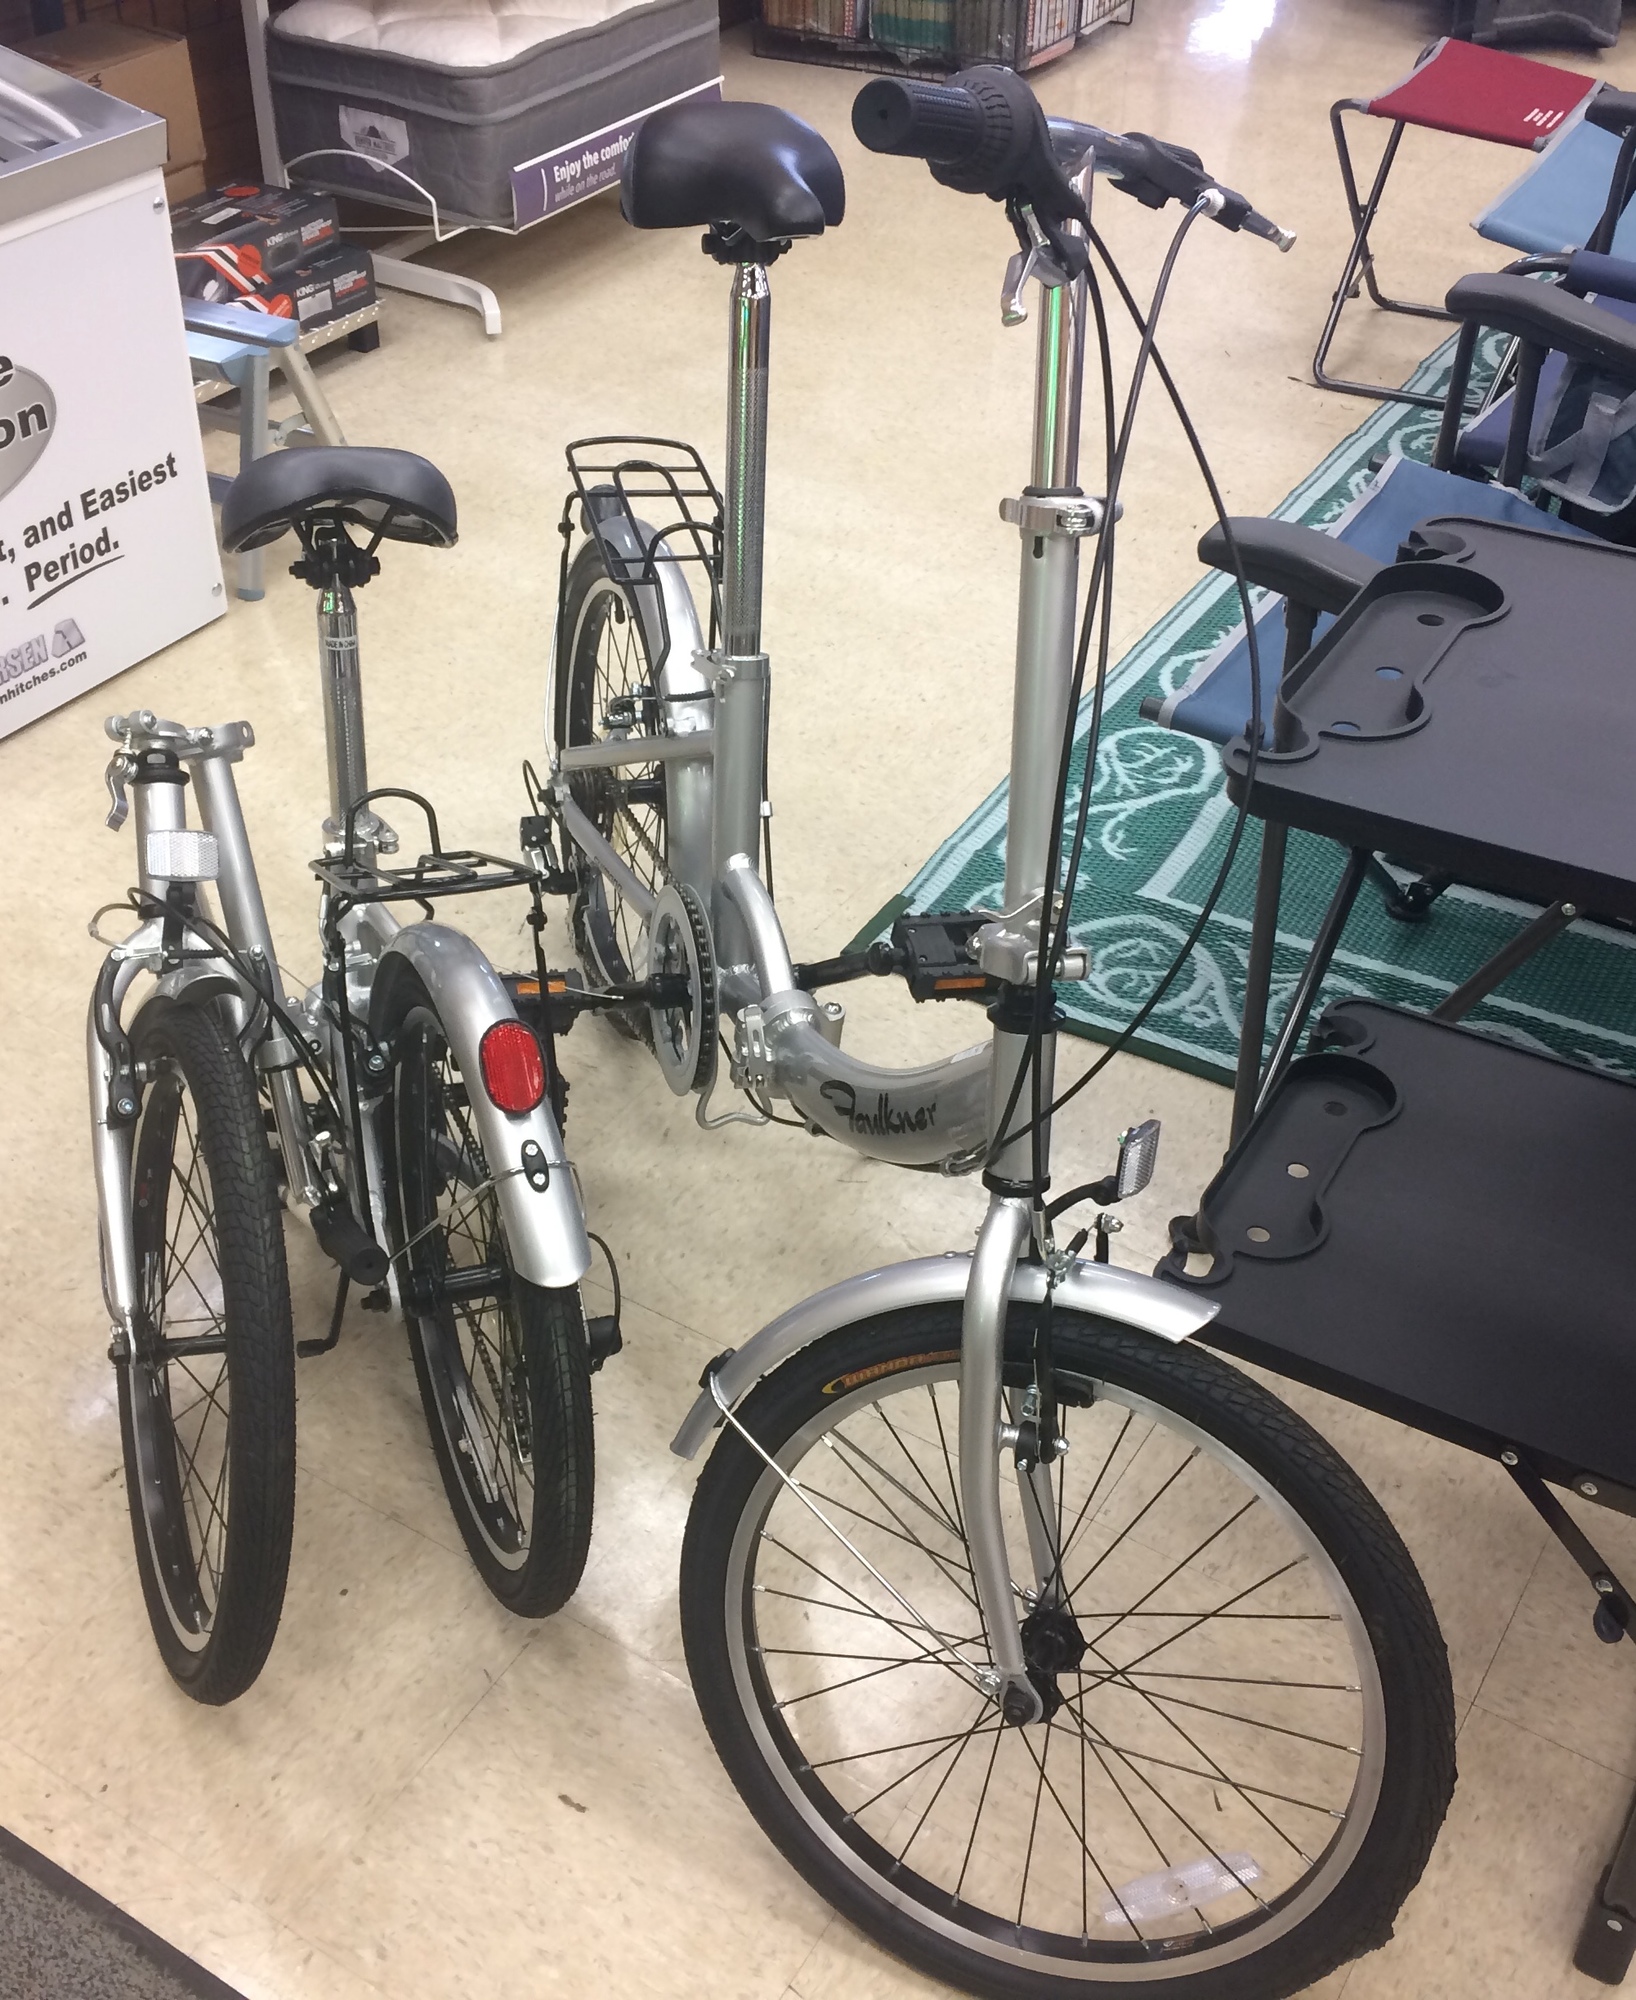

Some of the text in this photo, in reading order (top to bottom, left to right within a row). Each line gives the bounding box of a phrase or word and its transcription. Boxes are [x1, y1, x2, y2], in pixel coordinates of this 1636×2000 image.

[553, 160, 581, 183] Enjoy
[582, 150, 599, 169] the
[555, 183, 575, 202] while
[575, 180, 585, 193] on
[586, 173, 598, 188] the
[22, 501, 74, 549] and
[82, 452, 178, 520] Easiest
[24, 526, 120, 592] Period.
[819, 1080, 937, 1136] Faulkner
